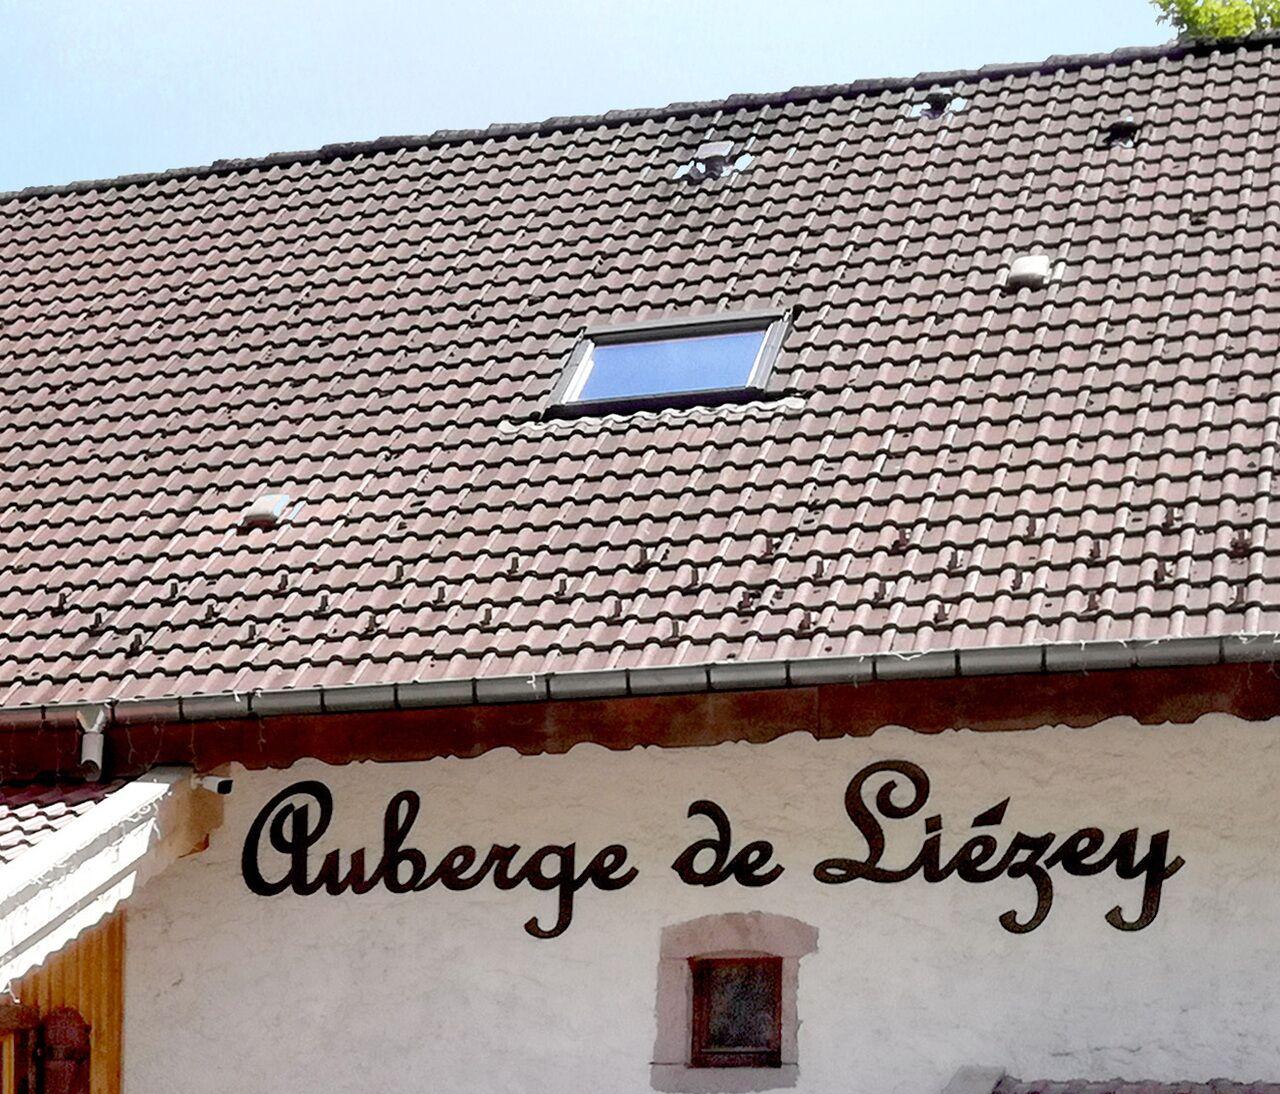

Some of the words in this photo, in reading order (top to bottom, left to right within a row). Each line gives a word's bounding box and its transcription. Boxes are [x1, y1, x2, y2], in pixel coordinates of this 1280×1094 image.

[241, 780, 638, 939] Auberge
[671, 800, 785, 887] de
[813, 759, 1185, 934] Liézey
